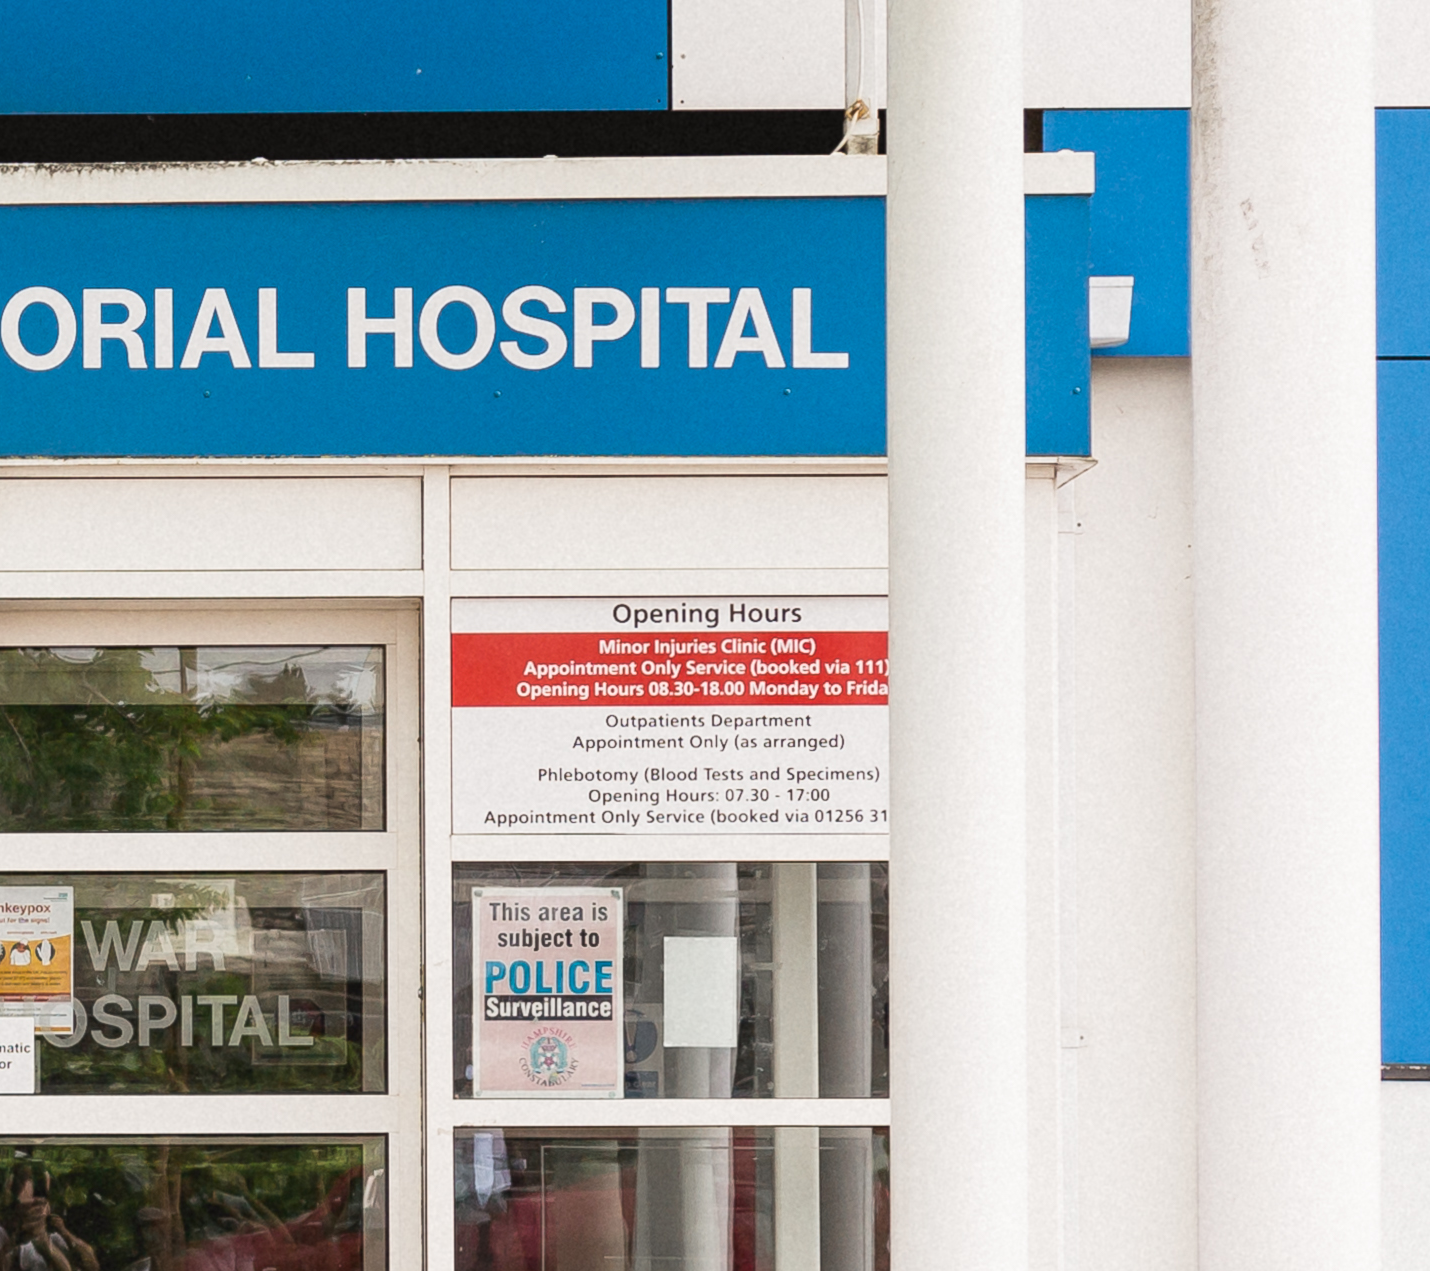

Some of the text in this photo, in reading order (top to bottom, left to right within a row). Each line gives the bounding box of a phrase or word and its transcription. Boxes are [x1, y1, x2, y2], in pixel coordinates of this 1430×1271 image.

[347, 286, 850, 370] HOSPITAL
[613, 603, 802, 627] Opening Hours
[599, 638, 816, 657] Minor Injuries Clinic (MIC)
[523, 659, 889, 679] Appointment Only Service (booked via 111)
[516, 682, 589, 700] Opening
[594, 682, 644, 697] Hours
[648, 681, 745, 697] 08.30-18.00
[750, 681, 819, 699] Monday
[823, 683, 842, 696] to
[606, 714, 811, 731] Outpatients Department
[572, 734, 845, 753] Appointment Only (as arranged)
[538, 766, 880, 786] Phlebotomy (Blood Tests and Specimens)
[588, 789, 660, 806] Opening
[666, 789, 720, 803] Hours:
[725, 788, 769, 802] 07.30
[787, 788, 830, 802] 17:00
[484, 808, 888, 828] Appointment Only Service (booked via 01256 31
[489, 902, 608, 921] This area is
[81, 920, 226, 971] WAR
[498, 929, 600, 952] subject to
[485, 960, 612, 994] POLICE
[486, 997, 612, 1018] Surveillance
